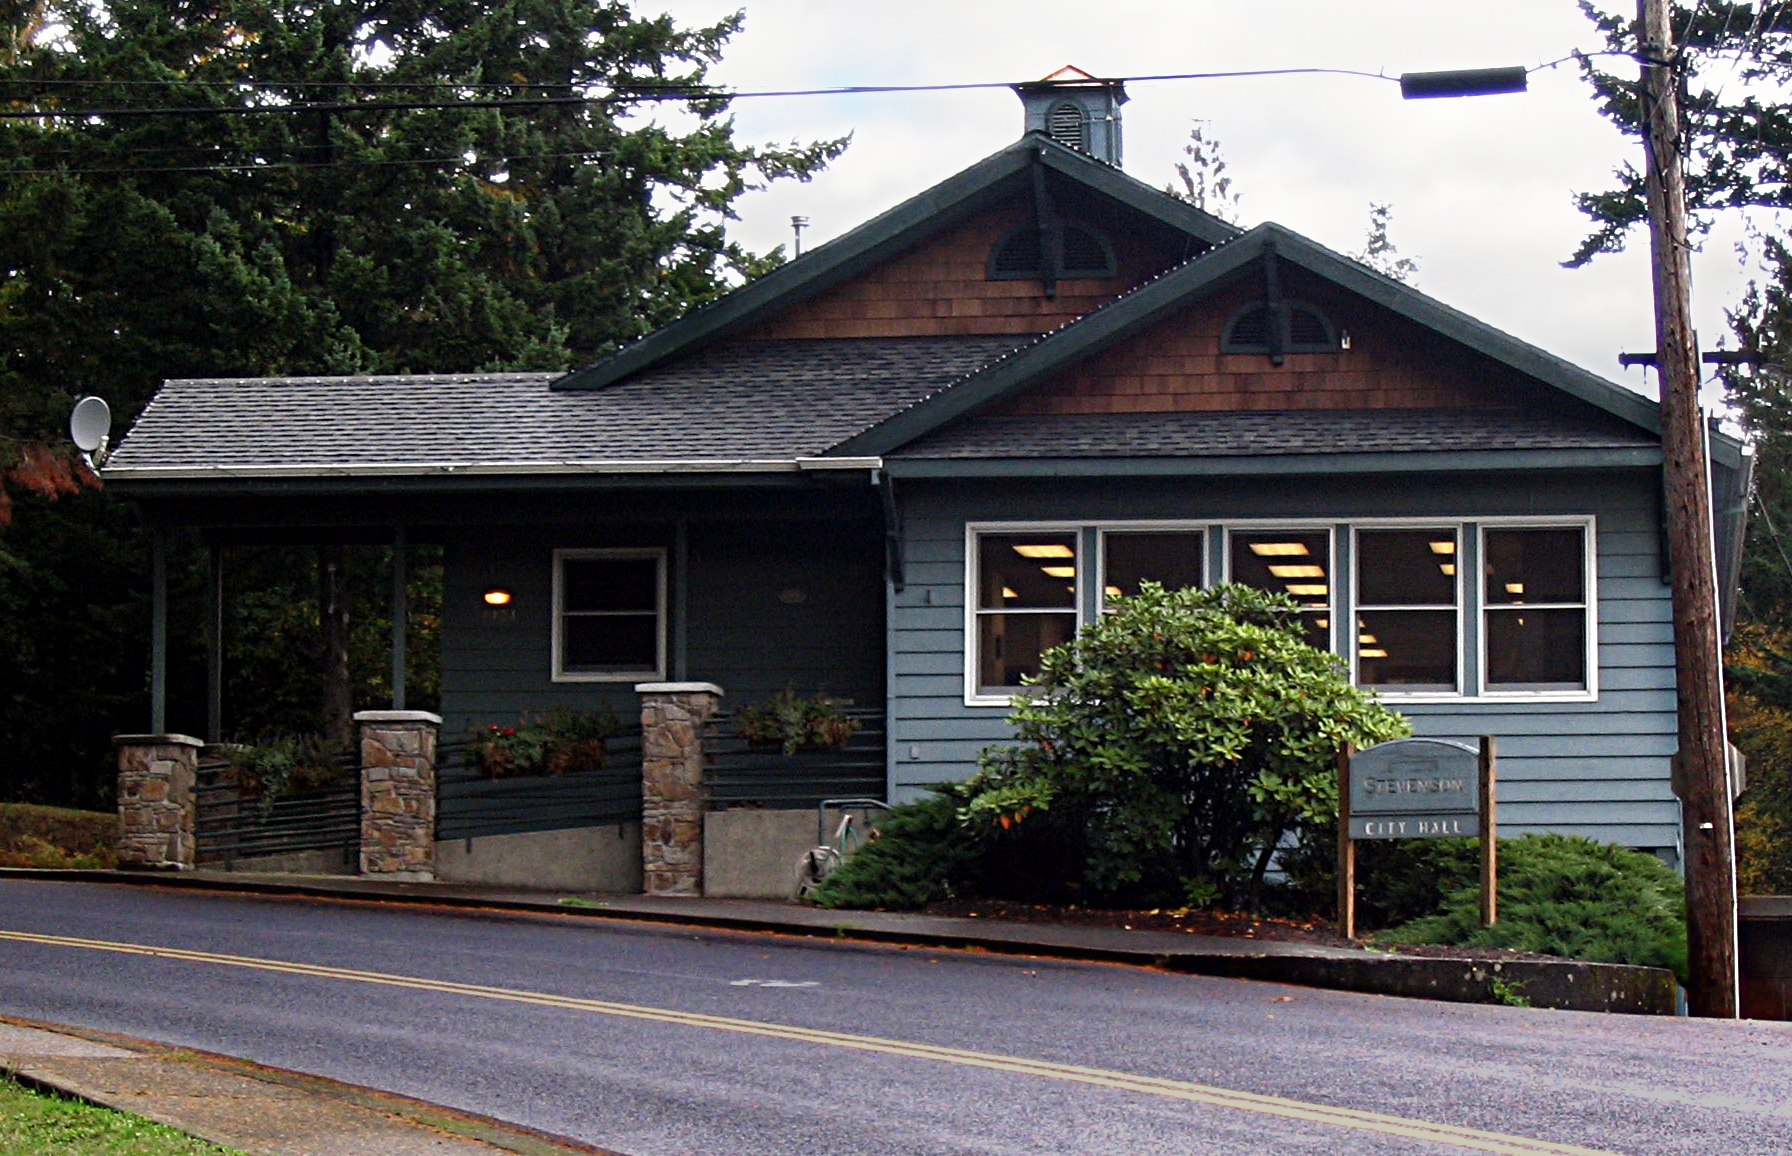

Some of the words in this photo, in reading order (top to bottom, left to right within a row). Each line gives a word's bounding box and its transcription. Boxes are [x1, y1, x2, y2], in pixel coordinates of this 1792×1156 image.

[1364, 776, 1464, 794] STEVENSON
[1364, 821, 1407, 836] CITY
[1418, 819, 1463, 835] HALL
